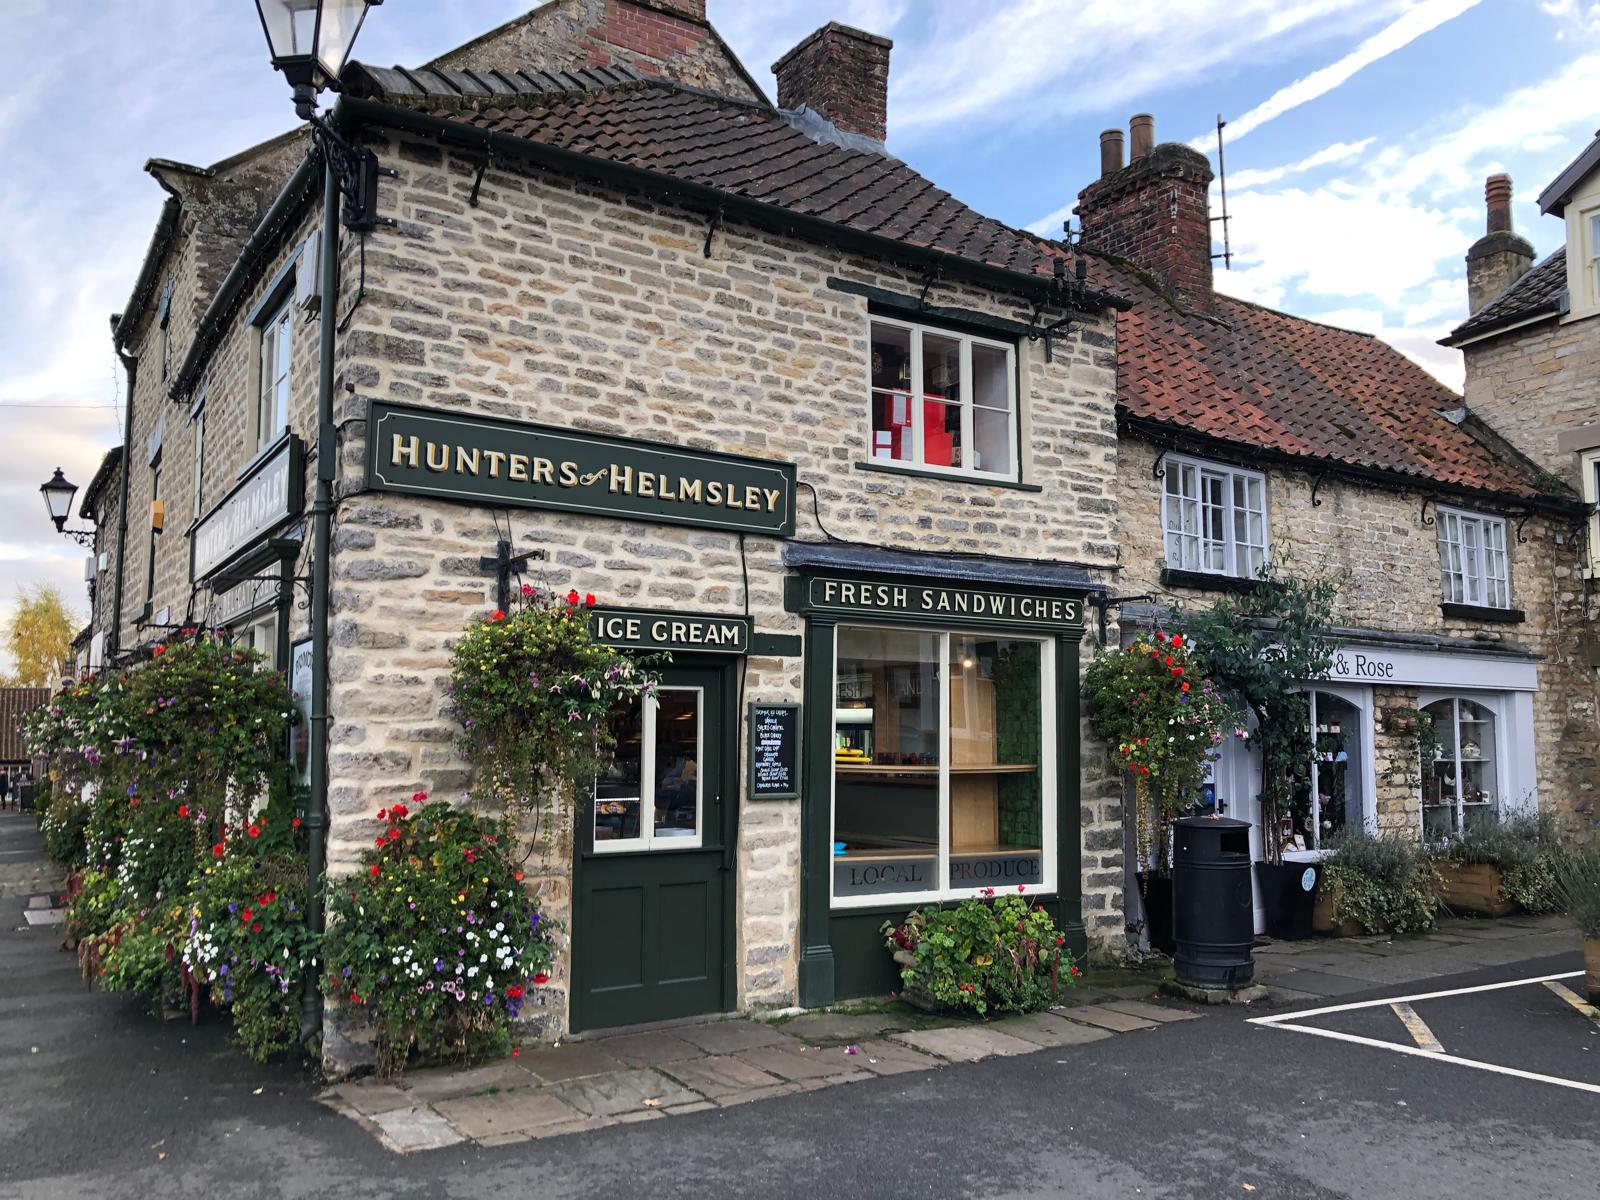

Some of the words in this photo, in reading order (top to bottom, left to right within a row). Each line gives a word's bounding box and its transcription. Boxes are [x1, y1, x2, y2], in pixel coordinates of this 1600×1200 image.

[391, 433, 579, 488] HUNTERS
[609, 463, 781, 512] HELMSLEY
[233, 464, 288, 542] HELMSLEY
[825, 581, 908, 608] FRESH
[921, 590, 1076, 620] SANDWICHES
[597, 616, 641, 640] ICE
[651, 620, 739, 645] CREAM
[1335, 653, 1350, 675] &
[1355, 654, 1394, 678] Rose
[850, 864, 923, 886] LOCAL
[950, 858, 1040, 881] PRODUCE
